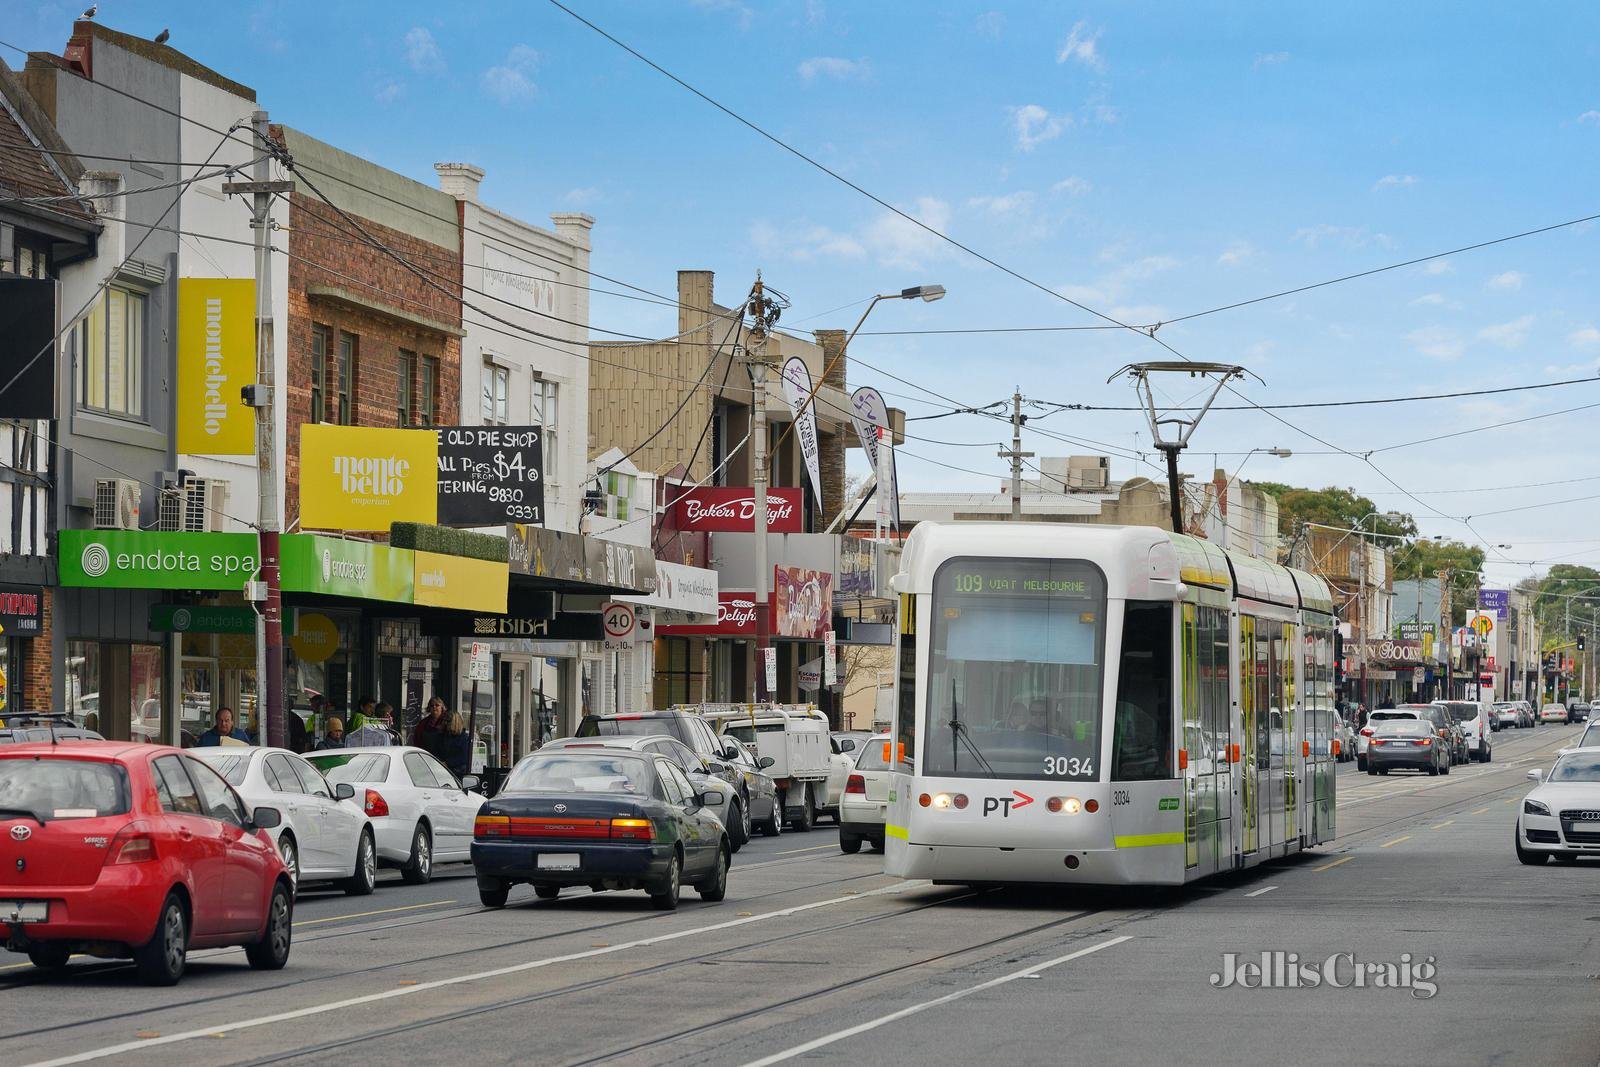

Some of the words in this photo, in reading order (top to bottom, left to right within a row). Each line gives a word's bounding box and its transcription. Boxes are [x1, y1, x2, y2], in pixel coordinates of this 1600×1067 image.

[205, 298, 227, 435] montebello
[447, 430, 475, 445] OLD
[477, 430, 500, 446] PIE
[502, 431, 539, 448] SHOP
[332, 453, 410, 478] monte
[460, 457, 491, 474] Pies
[492, 450, 526, 481] $4
[342, 472, 404, 496] bello
[437, 480, 487, 494] TERING
[471, 472, 495, 481] FROM
[488, 486, 524, 503] 9830
[506, 504, 539, 520] 0331
[685, 499, 735, 524] Bakers
[740, 501, 793, 525] Dight
[116, 549, 201, 572] endota
[210, 554, 258, 575] spa
[332, 557, 354, 580] endota
[955, 574, 983, 593] 109
[1023, 580, 1085, 592] MELBOURNE
[0, 593, 38, 615] UMPLING
[607, 614, 629, 628] 40
[718, 605, 757, 627] Deligh
[1043, 756, 1093, 777] 3034
[983, 797, 1014, 819] PT
[1113, 790, 1130, 806] 3034
